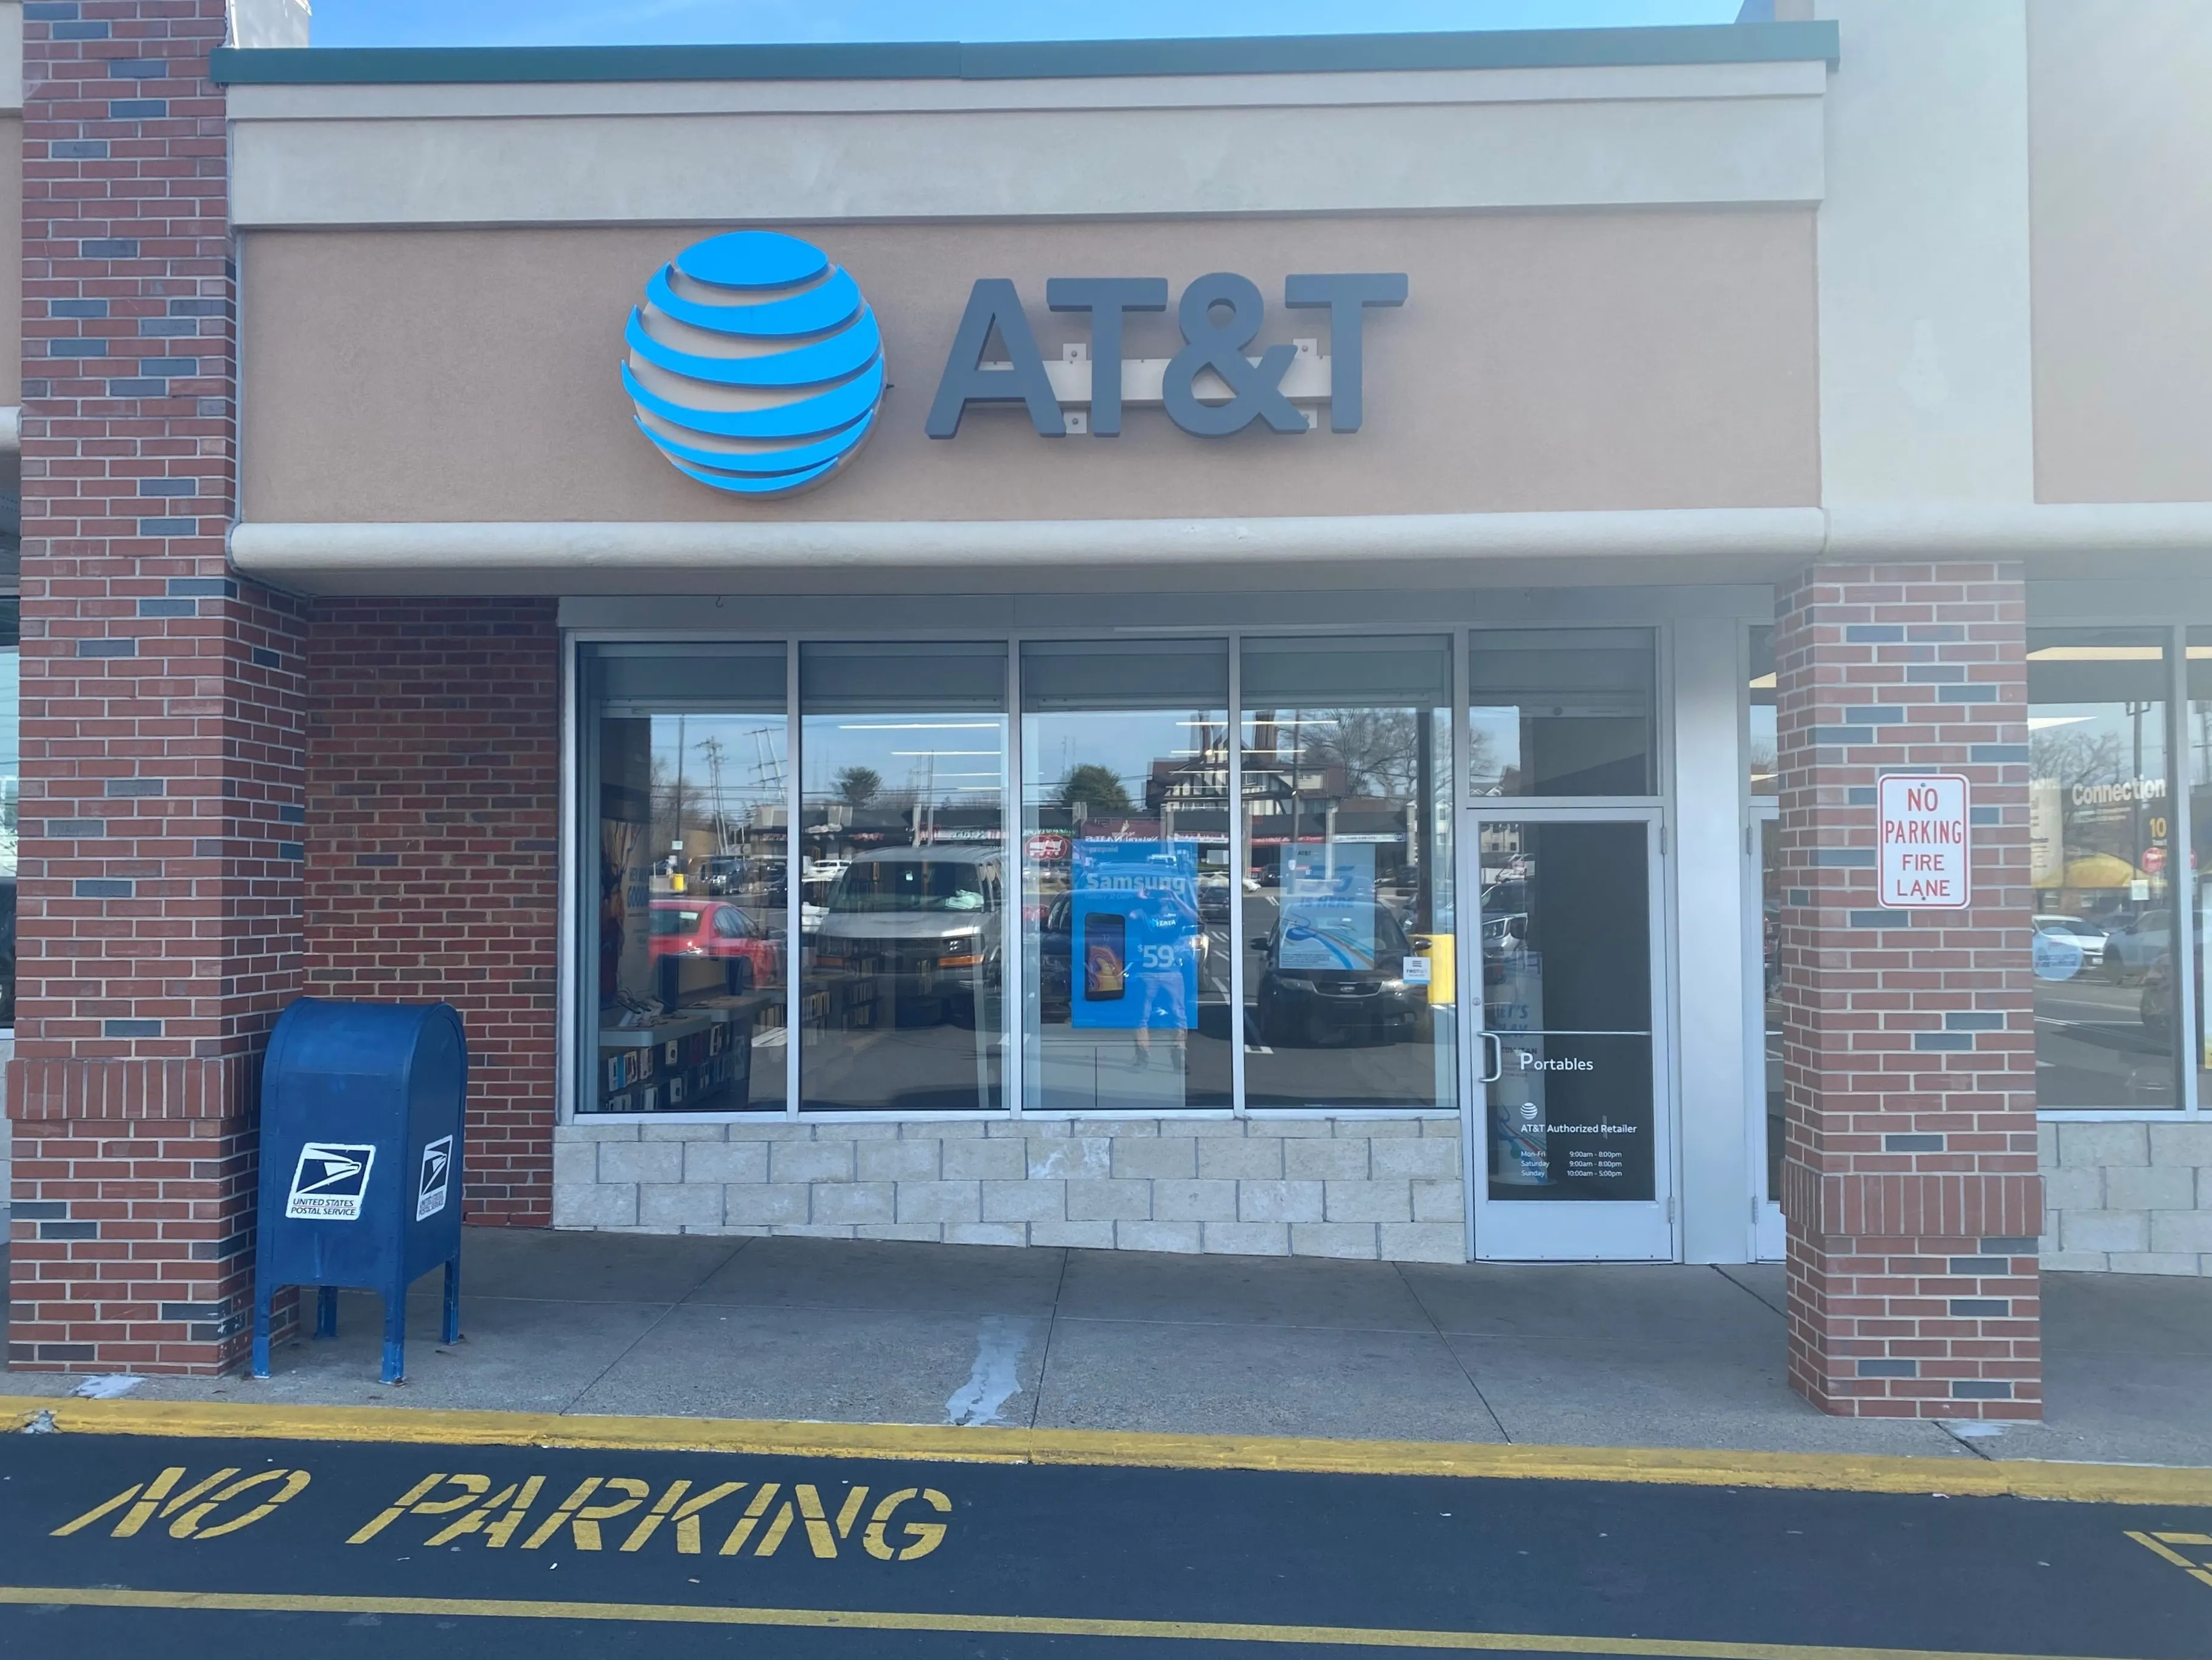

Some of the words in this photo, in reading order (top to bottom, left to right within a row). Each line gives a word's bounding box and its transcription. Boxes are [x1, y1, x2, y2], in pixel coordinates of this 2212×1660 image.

[925, 272, 1408, 439] AT&T
[1908, 788, 1938, 812] NO
[2072, 774, 2166, 806] Connection
[1886, 820, 1962, 844] PARKING
[1902, 854, 1945, 871] FIRE
[1086, 872, 1186, 895] Samsung
[1897, 879, 1950, 896] LANE
[1521, 1053, 1593, 1071] Portables
[1547, 1124, 1599, 1133] Authorized
[1601, 1124, 1637, 1133] Retailer
[49, 1467, 311, 1540] NO
[345, 1473, 953, 1561] PARKING
